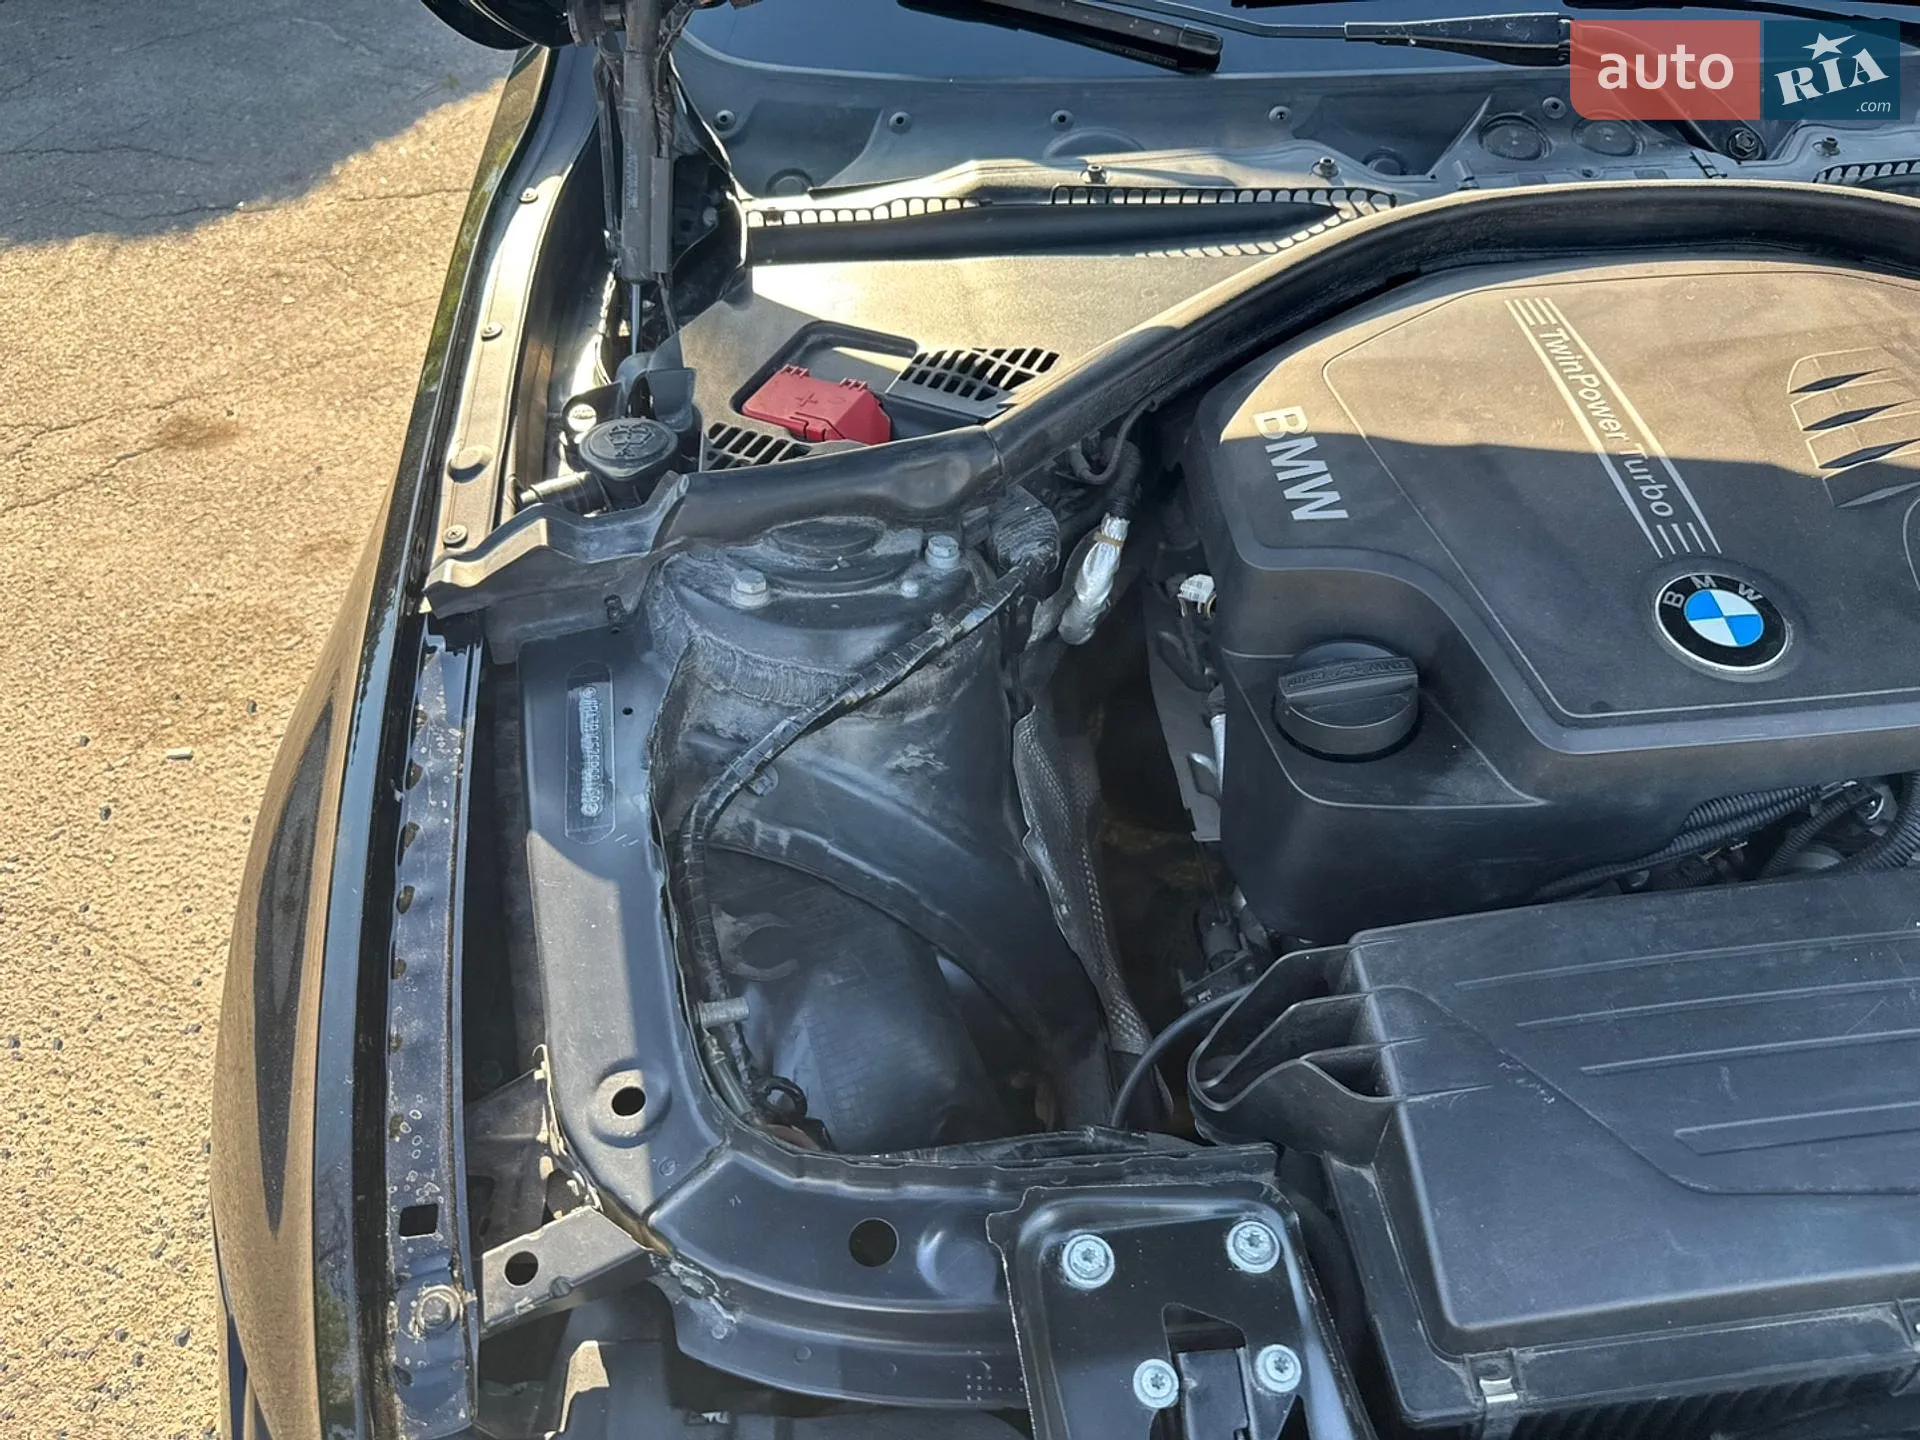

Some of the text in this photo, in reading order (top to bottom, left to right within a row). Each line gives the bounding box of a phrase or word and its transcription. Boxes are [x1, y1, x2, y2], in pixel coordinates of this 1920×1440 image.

[1253, 405, 1349, 520] BMW
[1539, 327, 1674, 517] TwinPower Turbo
[1662, 574, 1763, 609] BMW
